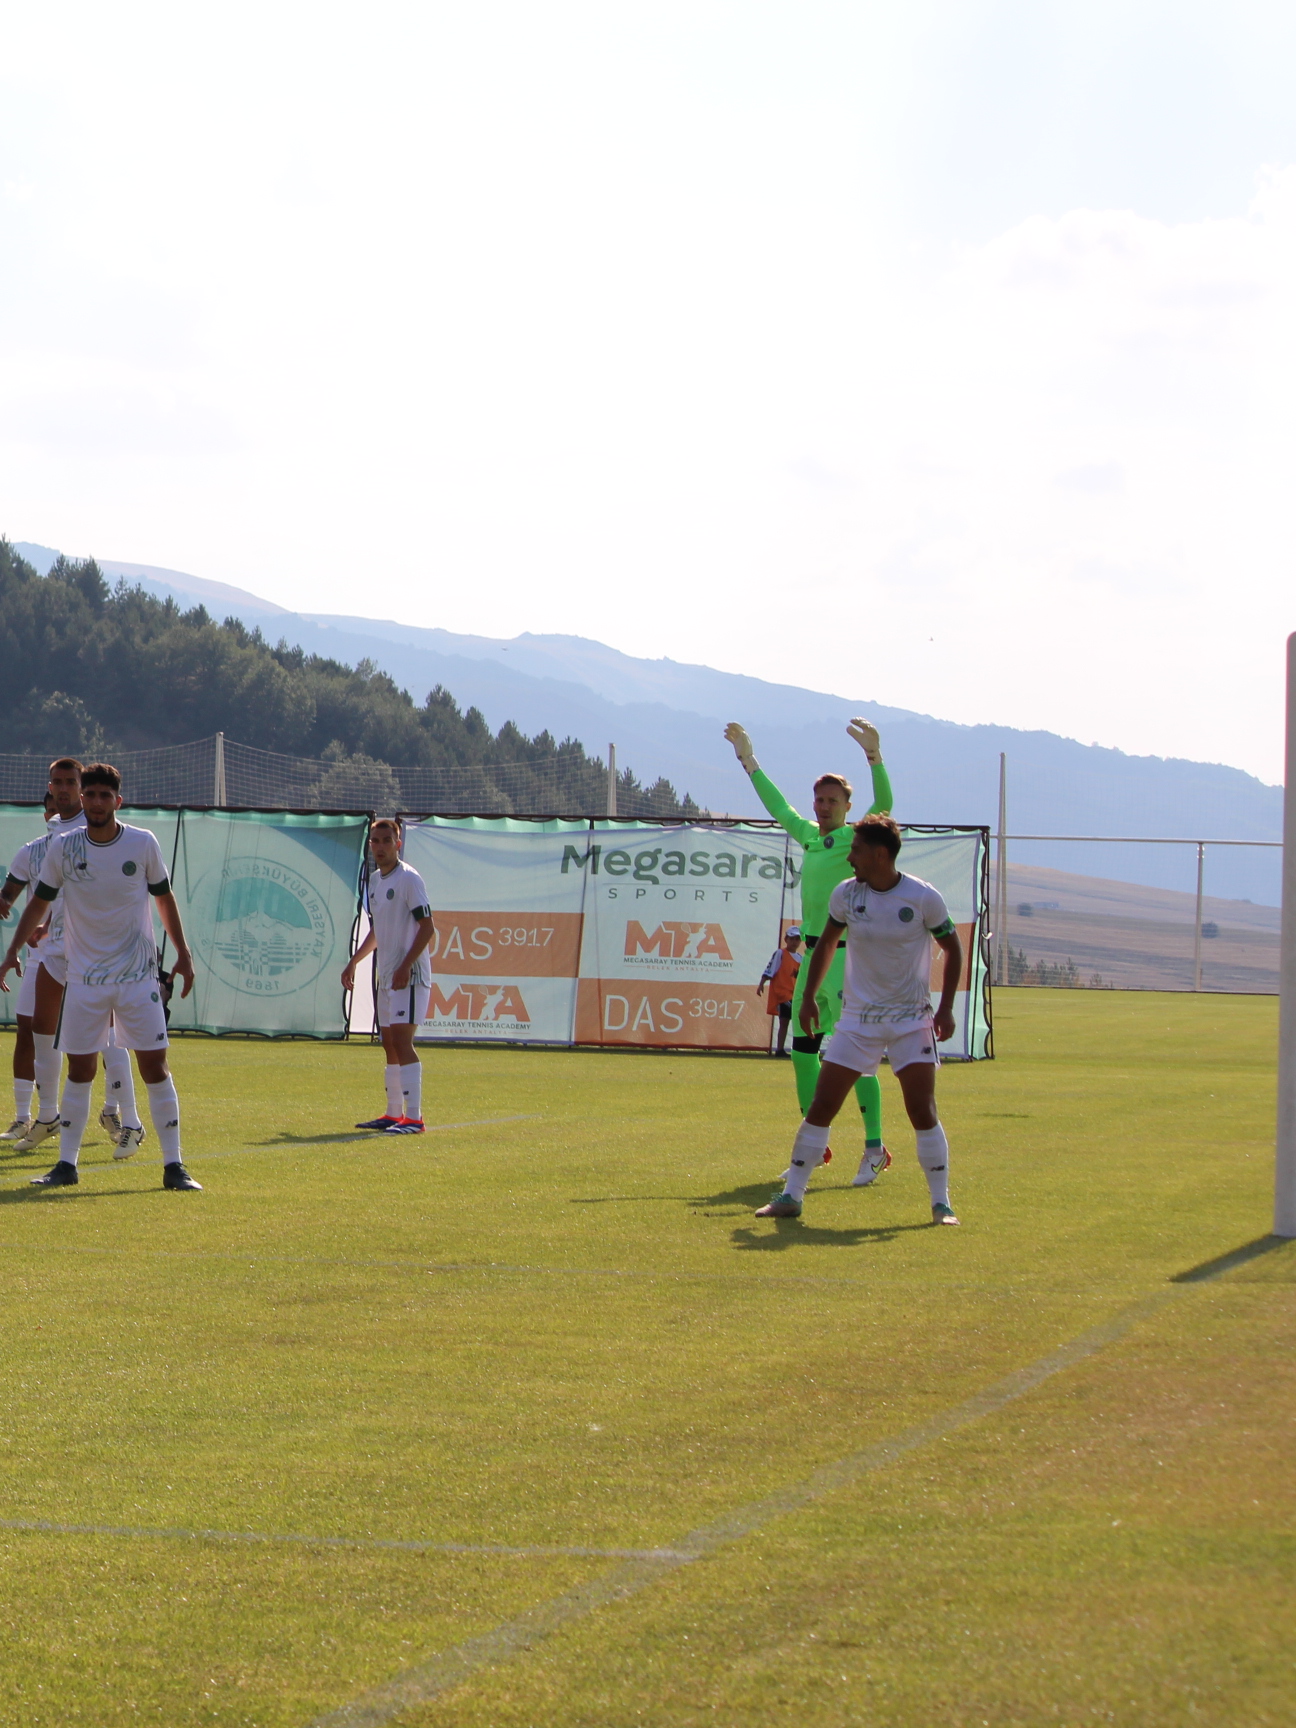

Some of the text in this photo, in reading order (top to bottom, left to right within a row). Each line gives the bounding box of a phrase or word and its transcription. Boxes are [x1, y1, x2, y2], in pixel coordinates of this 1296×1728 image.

[561, 844, 801, 889] Megasaray
[608, 887, 759, 903] SPORTS
[498, 927, 554, 947] 3917
[624, 919, 734, 960] MTA
[624, 957, 668, 965] MEGASARAY
[425, 982, 531, 1022] MTA
[604, 994, 745, 1033] DAS 3917
